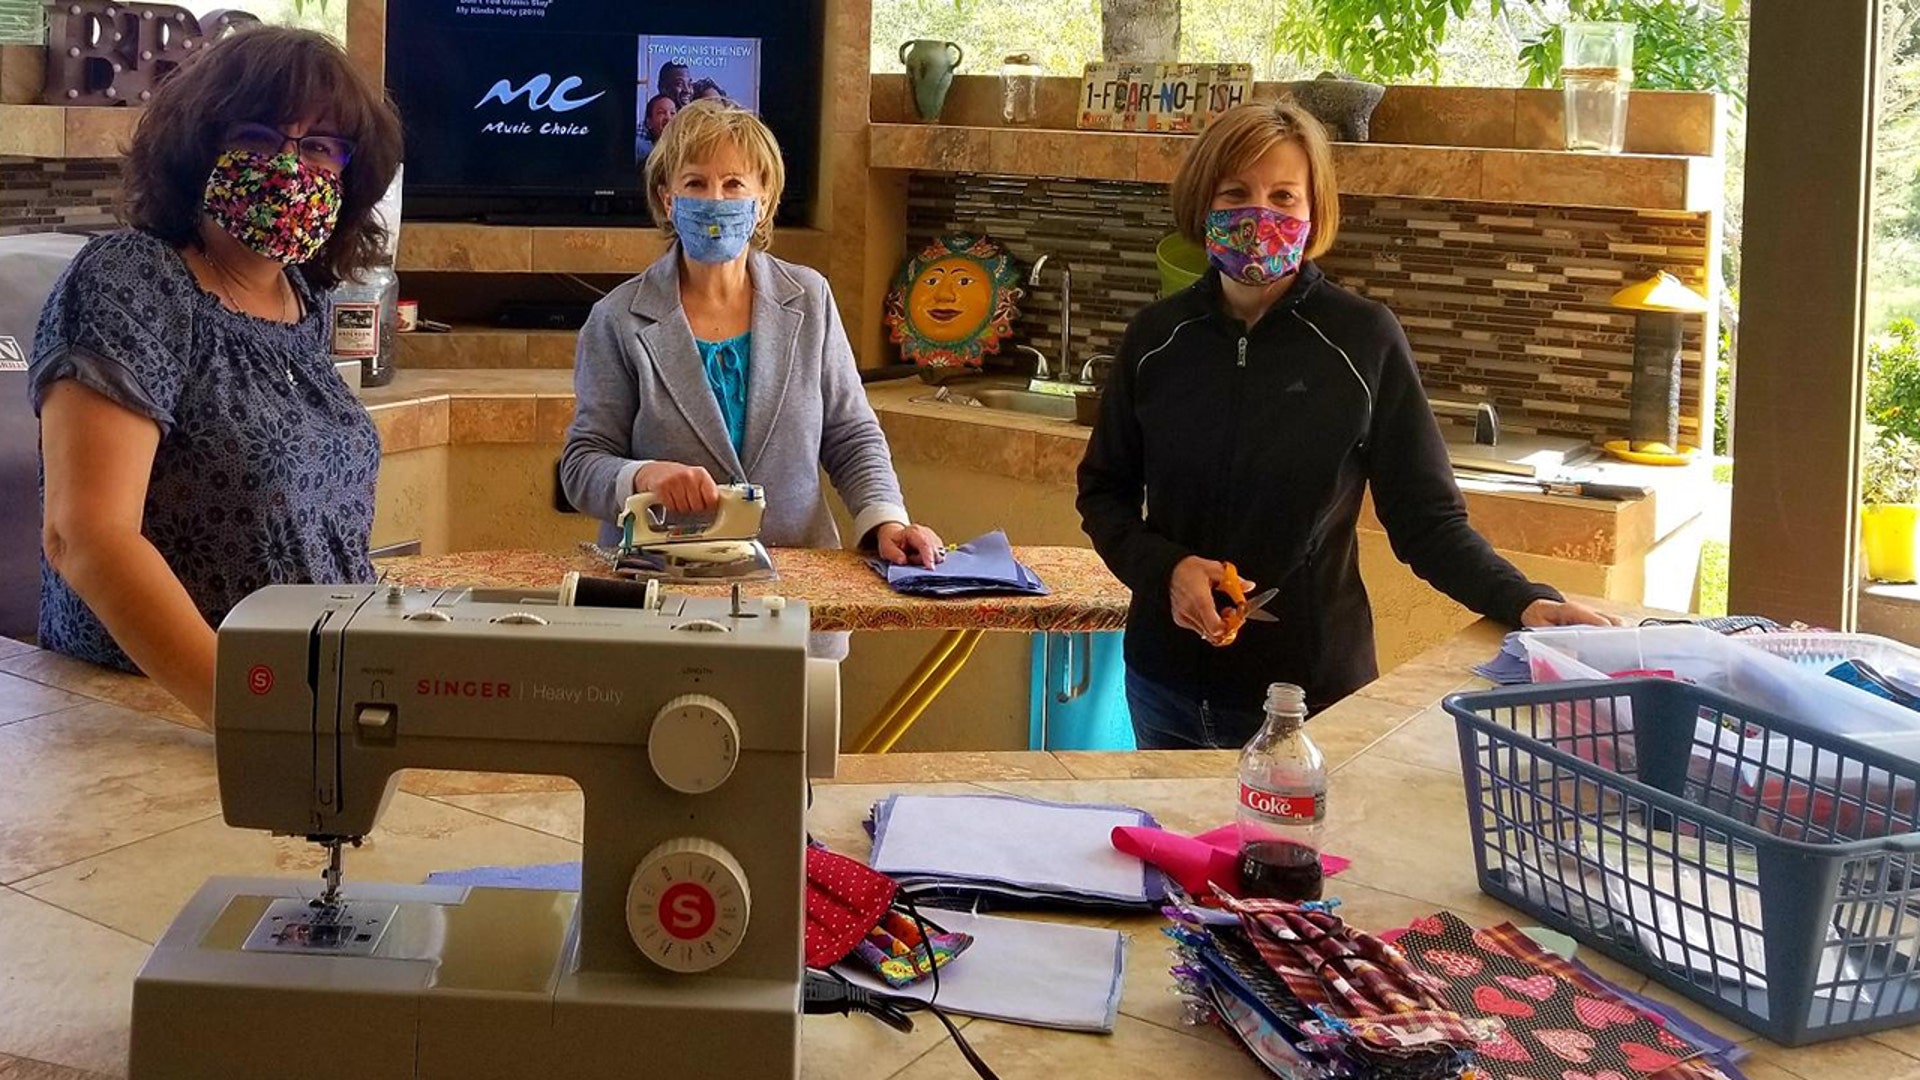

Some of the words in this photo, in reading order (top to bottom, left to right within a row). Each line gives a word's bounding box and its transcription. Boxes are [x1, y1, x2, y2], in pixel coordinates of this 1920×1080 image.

[470, 6, 495, 15] Kinda
[496, 7, 518, 17] Party
[648, 44, 687, 54] STAYING
[700, 46, 708, 55] IS
[710, 46, 728, 55] THE
[729, 46, 752, 56] NEW
[671, 56, 703, 66] GOING
[704, 57, 727, 67] OUT!
[481, 121, 532, 134] Music
[539, 122, 590, 135] Choice
[417, 680, 511, 699] SINGER
[533, 684, 582, 703] Heavy
[587, 686, 624, 704] Duty
[1248, 791, 1292, 816] Coke
